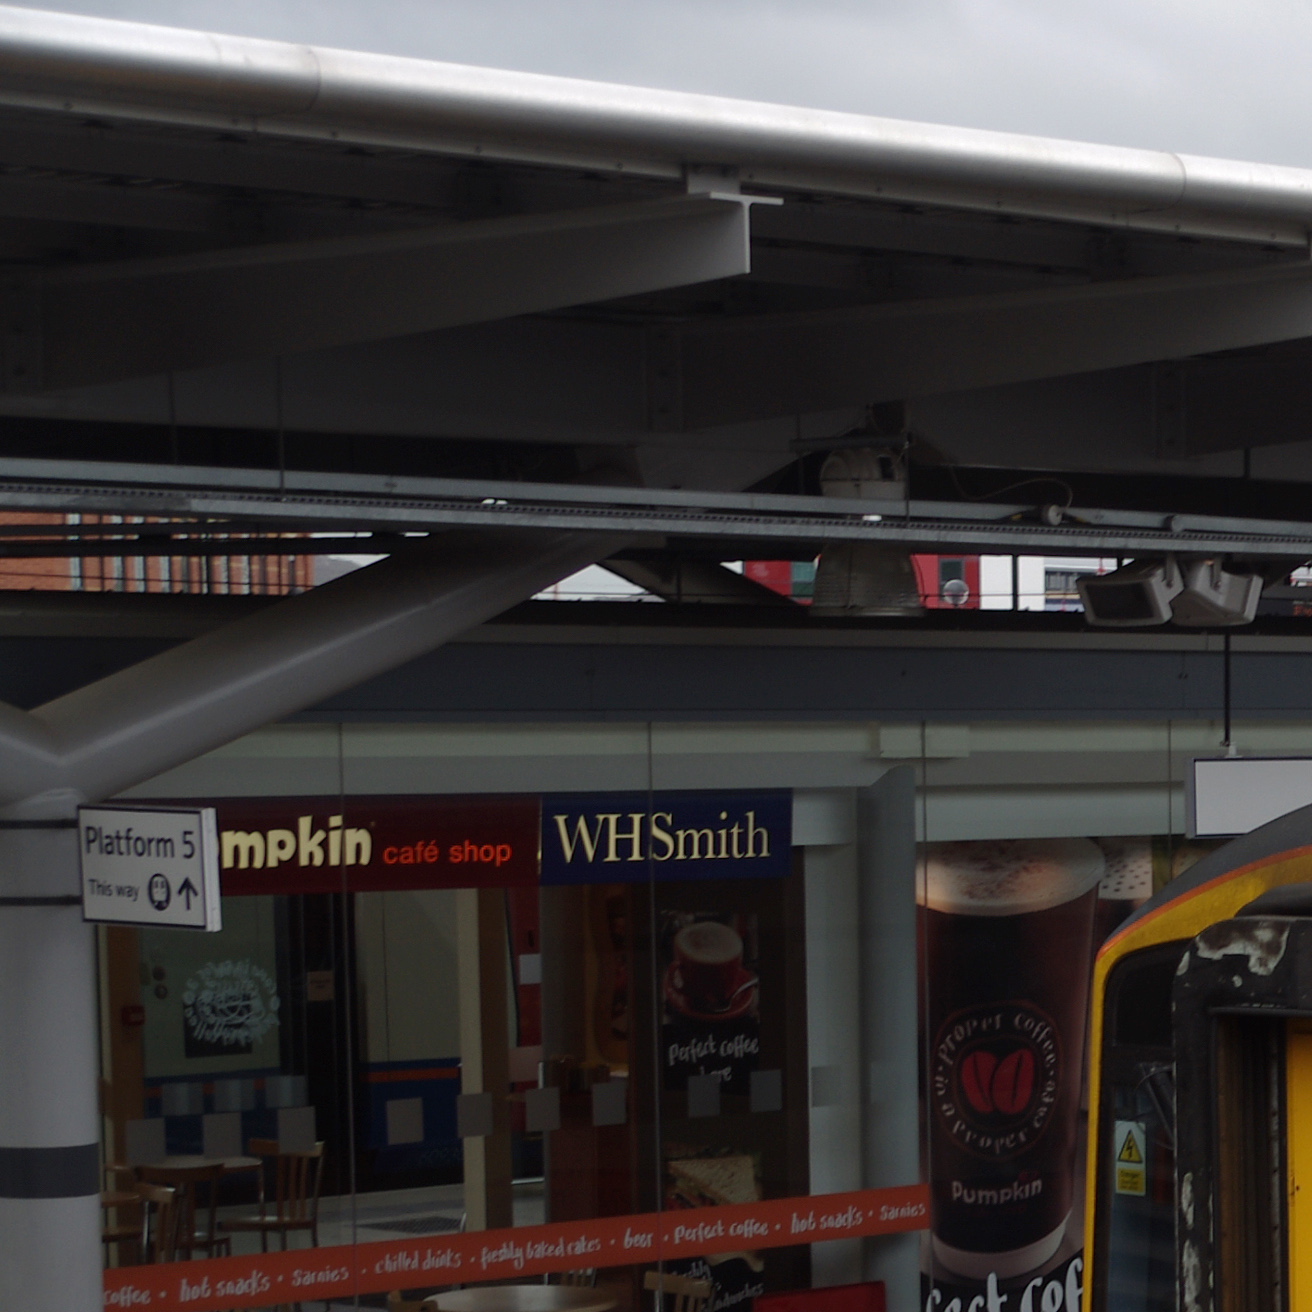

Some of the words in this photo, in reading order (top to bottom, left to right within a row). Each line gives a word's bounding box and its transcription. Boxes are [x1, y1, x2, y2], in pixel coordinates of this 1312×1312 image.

[85, 825, 175, 859] Platform
[183, 829, 196, 859] 5
[218, 814, 373, 870] mpkin
[382, 839, 440, 866] café
[449, 839, 513, 867] shop
[552, 810, 772, 865] WHSmith
[88, 878, 113, 898] This
[116, 883, 140, 903] way
[1013, 1012, 1057, 1067] coffee
[951, 1178, 1043, 1206] Pumpkin
[105, 1284, 152, 1308] coffee
[178, 1275, 212, 1303] hot
[215, 1268, 271, 1297] snacks
[375, 1249, 419, 1274] chilled
[422, 1247, 462, 1271] drinks
[480, 1241, 524, 1271] freshly
[525, 1236, 565, 1260] baked
[566, 1235, 602, 1256] cakes
[623, 1227, 654, 1250] beer
[728, 1218, 769, 1240] coffee
[790, 1212, 817, 1235] hot
[819, 1205, 864, 1230] snacks
